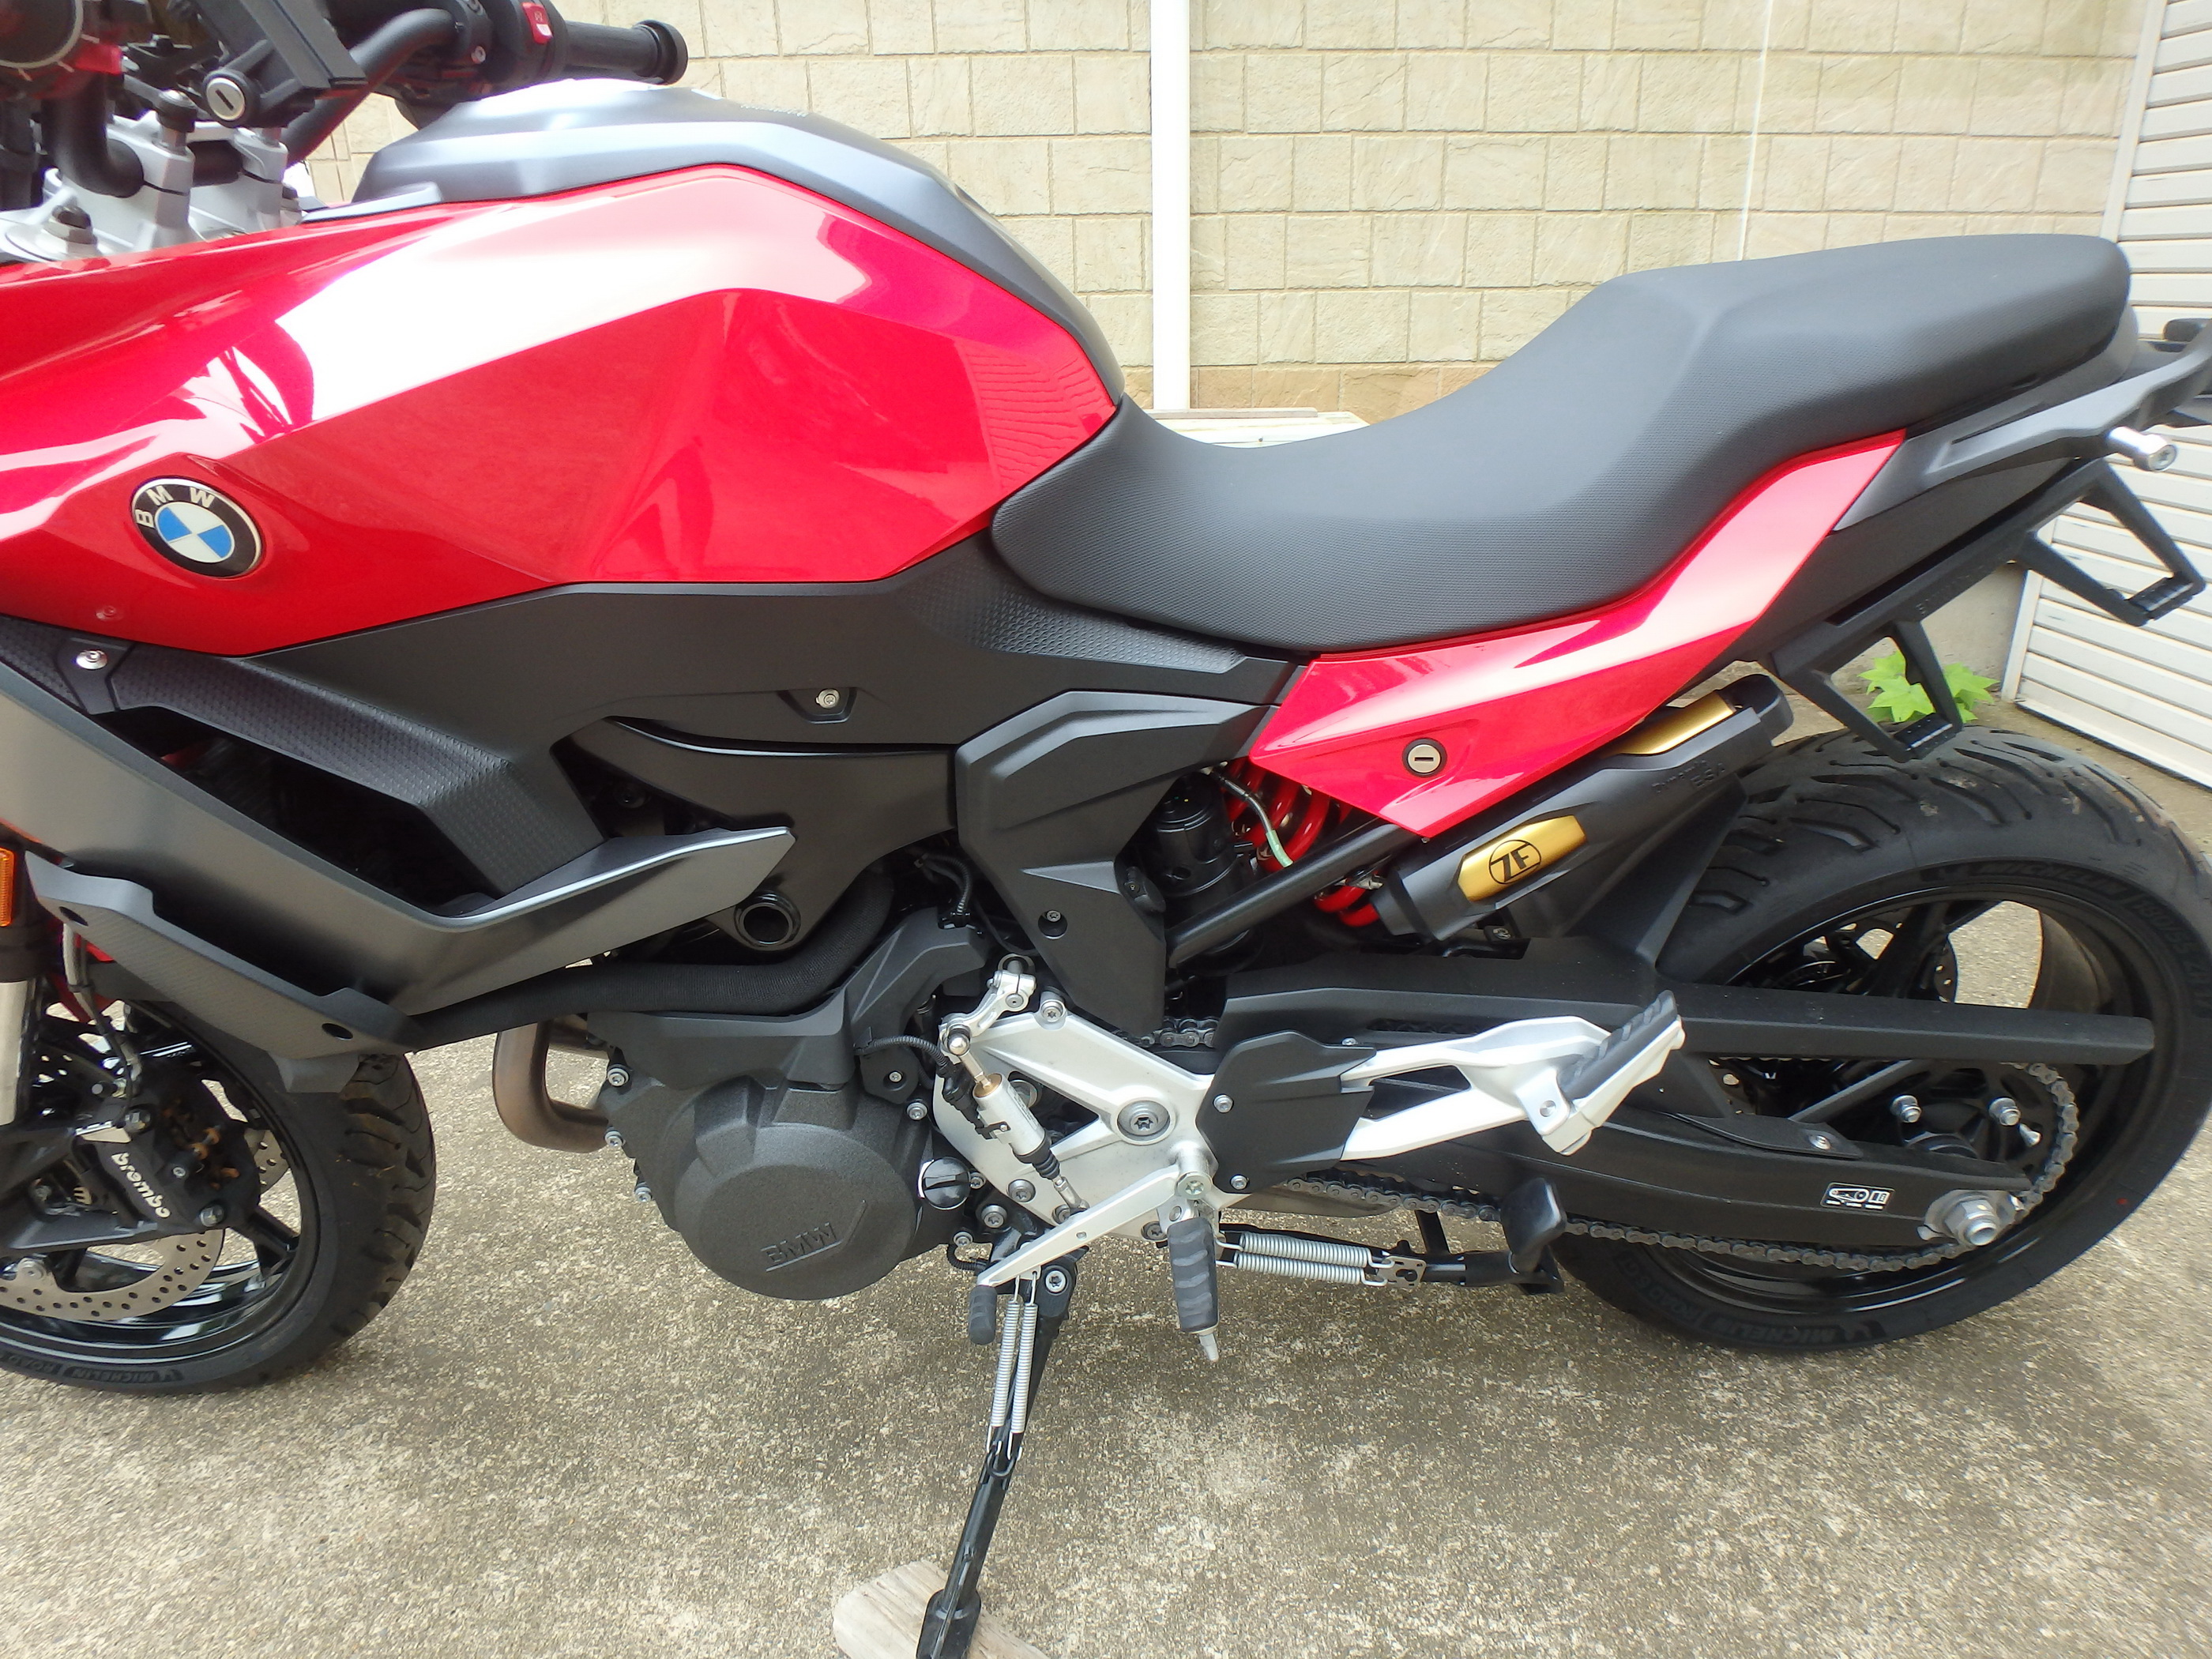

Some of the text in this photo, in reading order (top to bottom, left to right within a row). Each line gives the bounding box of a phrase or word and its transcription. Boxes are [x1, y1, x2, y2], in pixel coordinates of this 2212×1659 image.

[135, 486, 215, 528] BMW
[1490, 842, 1532, 882] ZF
[111, 1153, 171, 1217] brembo
[760, 1221, 837, 1263] BMW
[1717, 1316, 1835, 1344] MICHELIN
[72, 1368, 156, 1382] MICHELIN
